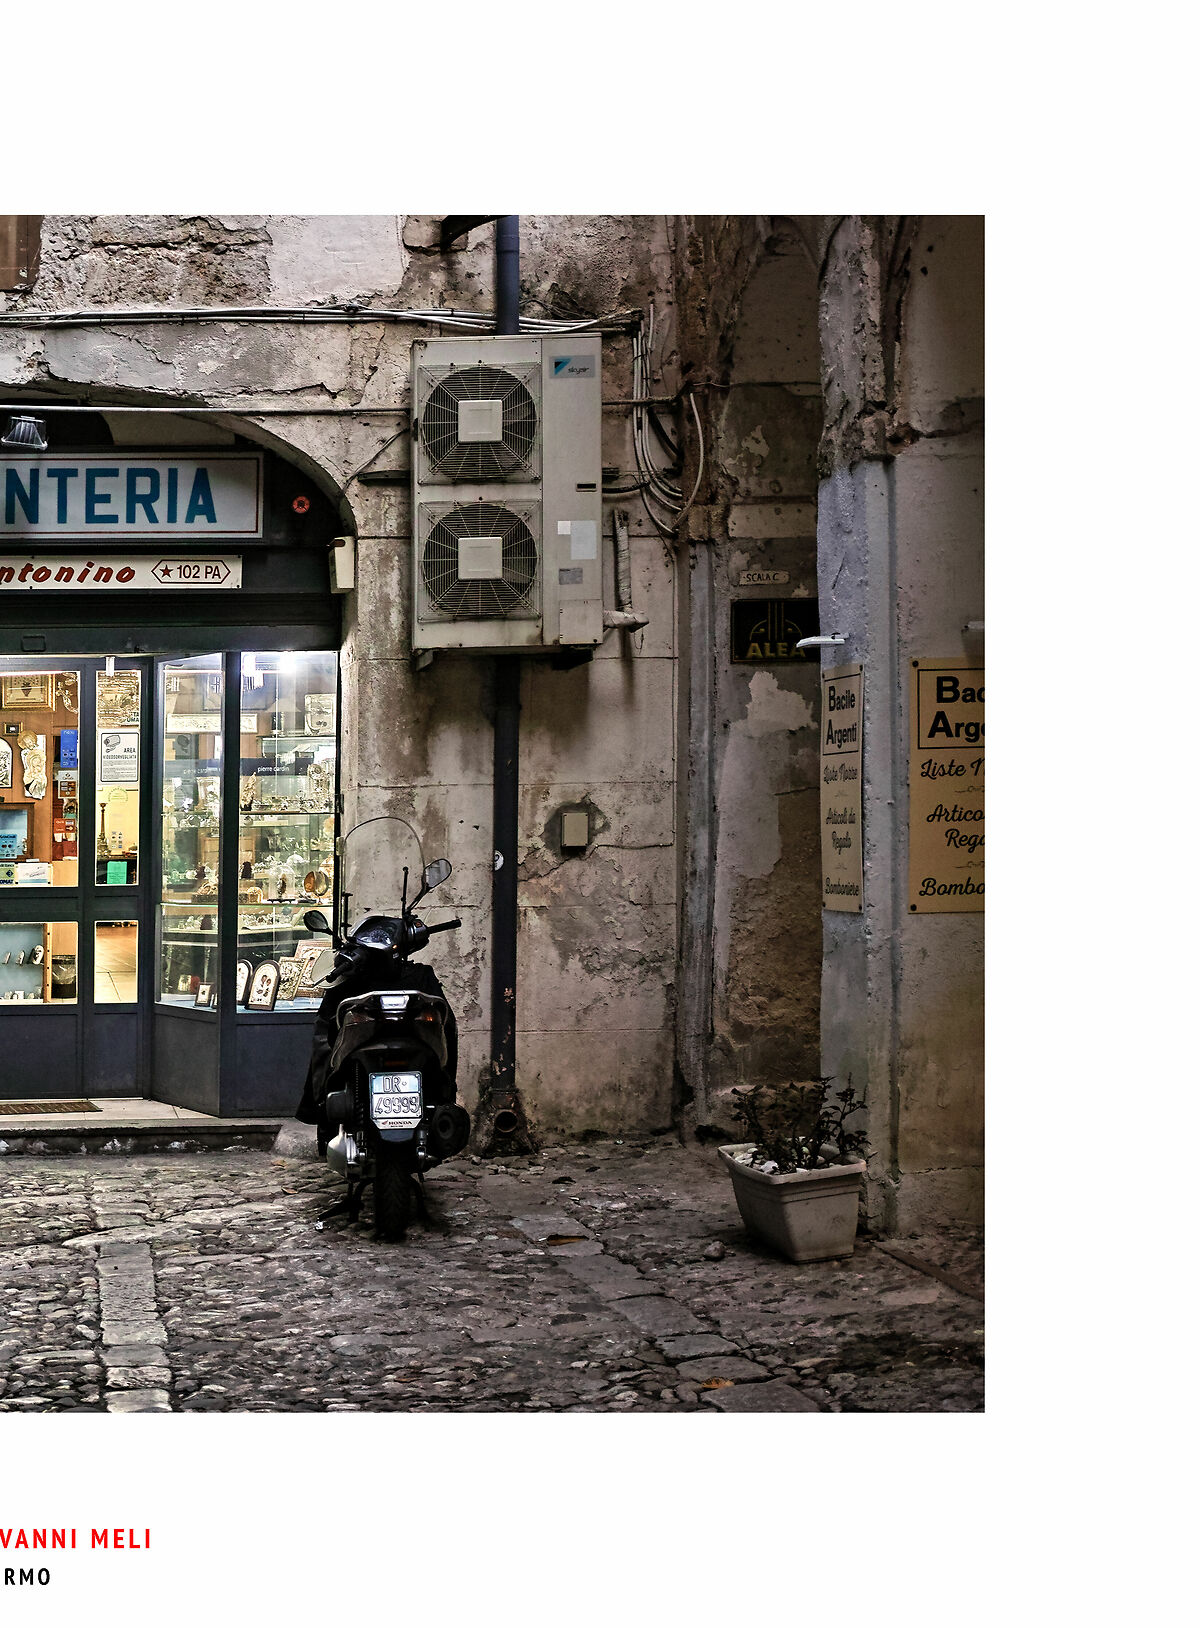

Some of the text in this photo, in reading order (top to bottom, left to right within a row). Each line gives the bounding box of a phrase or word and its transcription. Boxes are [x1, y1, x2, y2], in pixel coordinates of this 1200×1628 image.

[175, 564, 202, 580] 102
[203, 564, 222, 580] PA
[772, 572, 779, 581] C
[746, 642, 806, 658] ALEA
[828, 685, 856, 712] Bacile
[826, 719, 857, 749] Argenti
[927, 711, 985, 743] Arg
[920, 758, 967, 780] Liste
[825, 877, 860, 897] Bomboniere
[383, 1076, 402, 1093] DR
